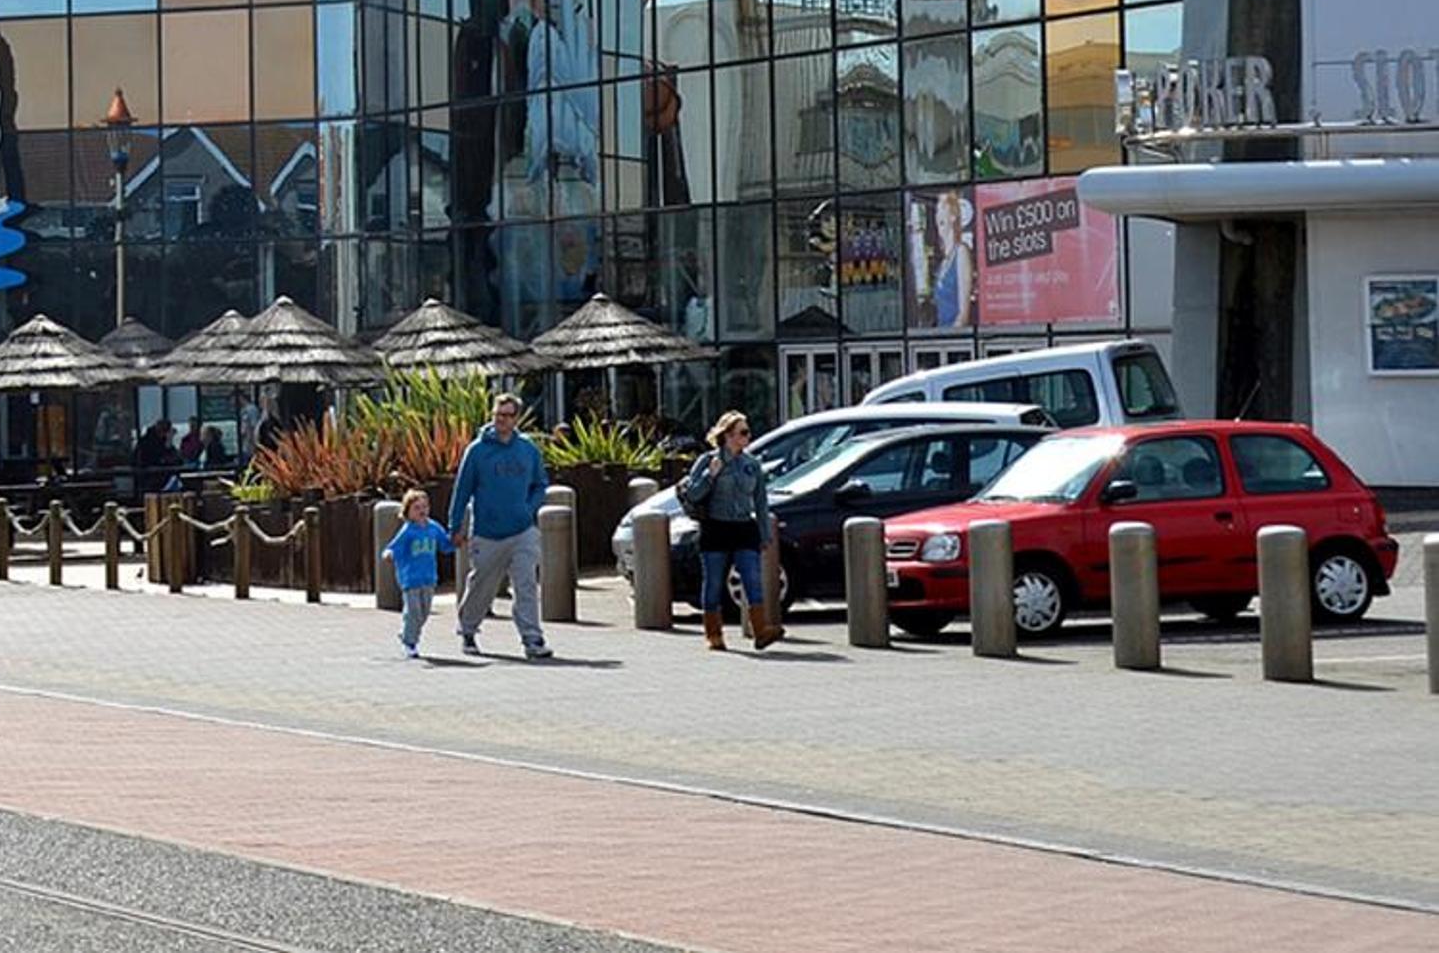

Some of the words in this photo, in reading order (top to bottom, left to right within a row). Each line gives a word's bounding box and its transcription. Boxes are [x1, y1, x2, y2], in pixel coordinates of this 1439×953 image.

[1158, 55, 1278, 131] POKER
[1352, 48, 1439, 125] SLO
[985, 208, 1015, 235] Win
[1016, 199, 1054, 229] £500
[1056, 199, 1076, 220] on
[988, 236, 1011, 261] the
[1012, 230, 1048, 256] slots
